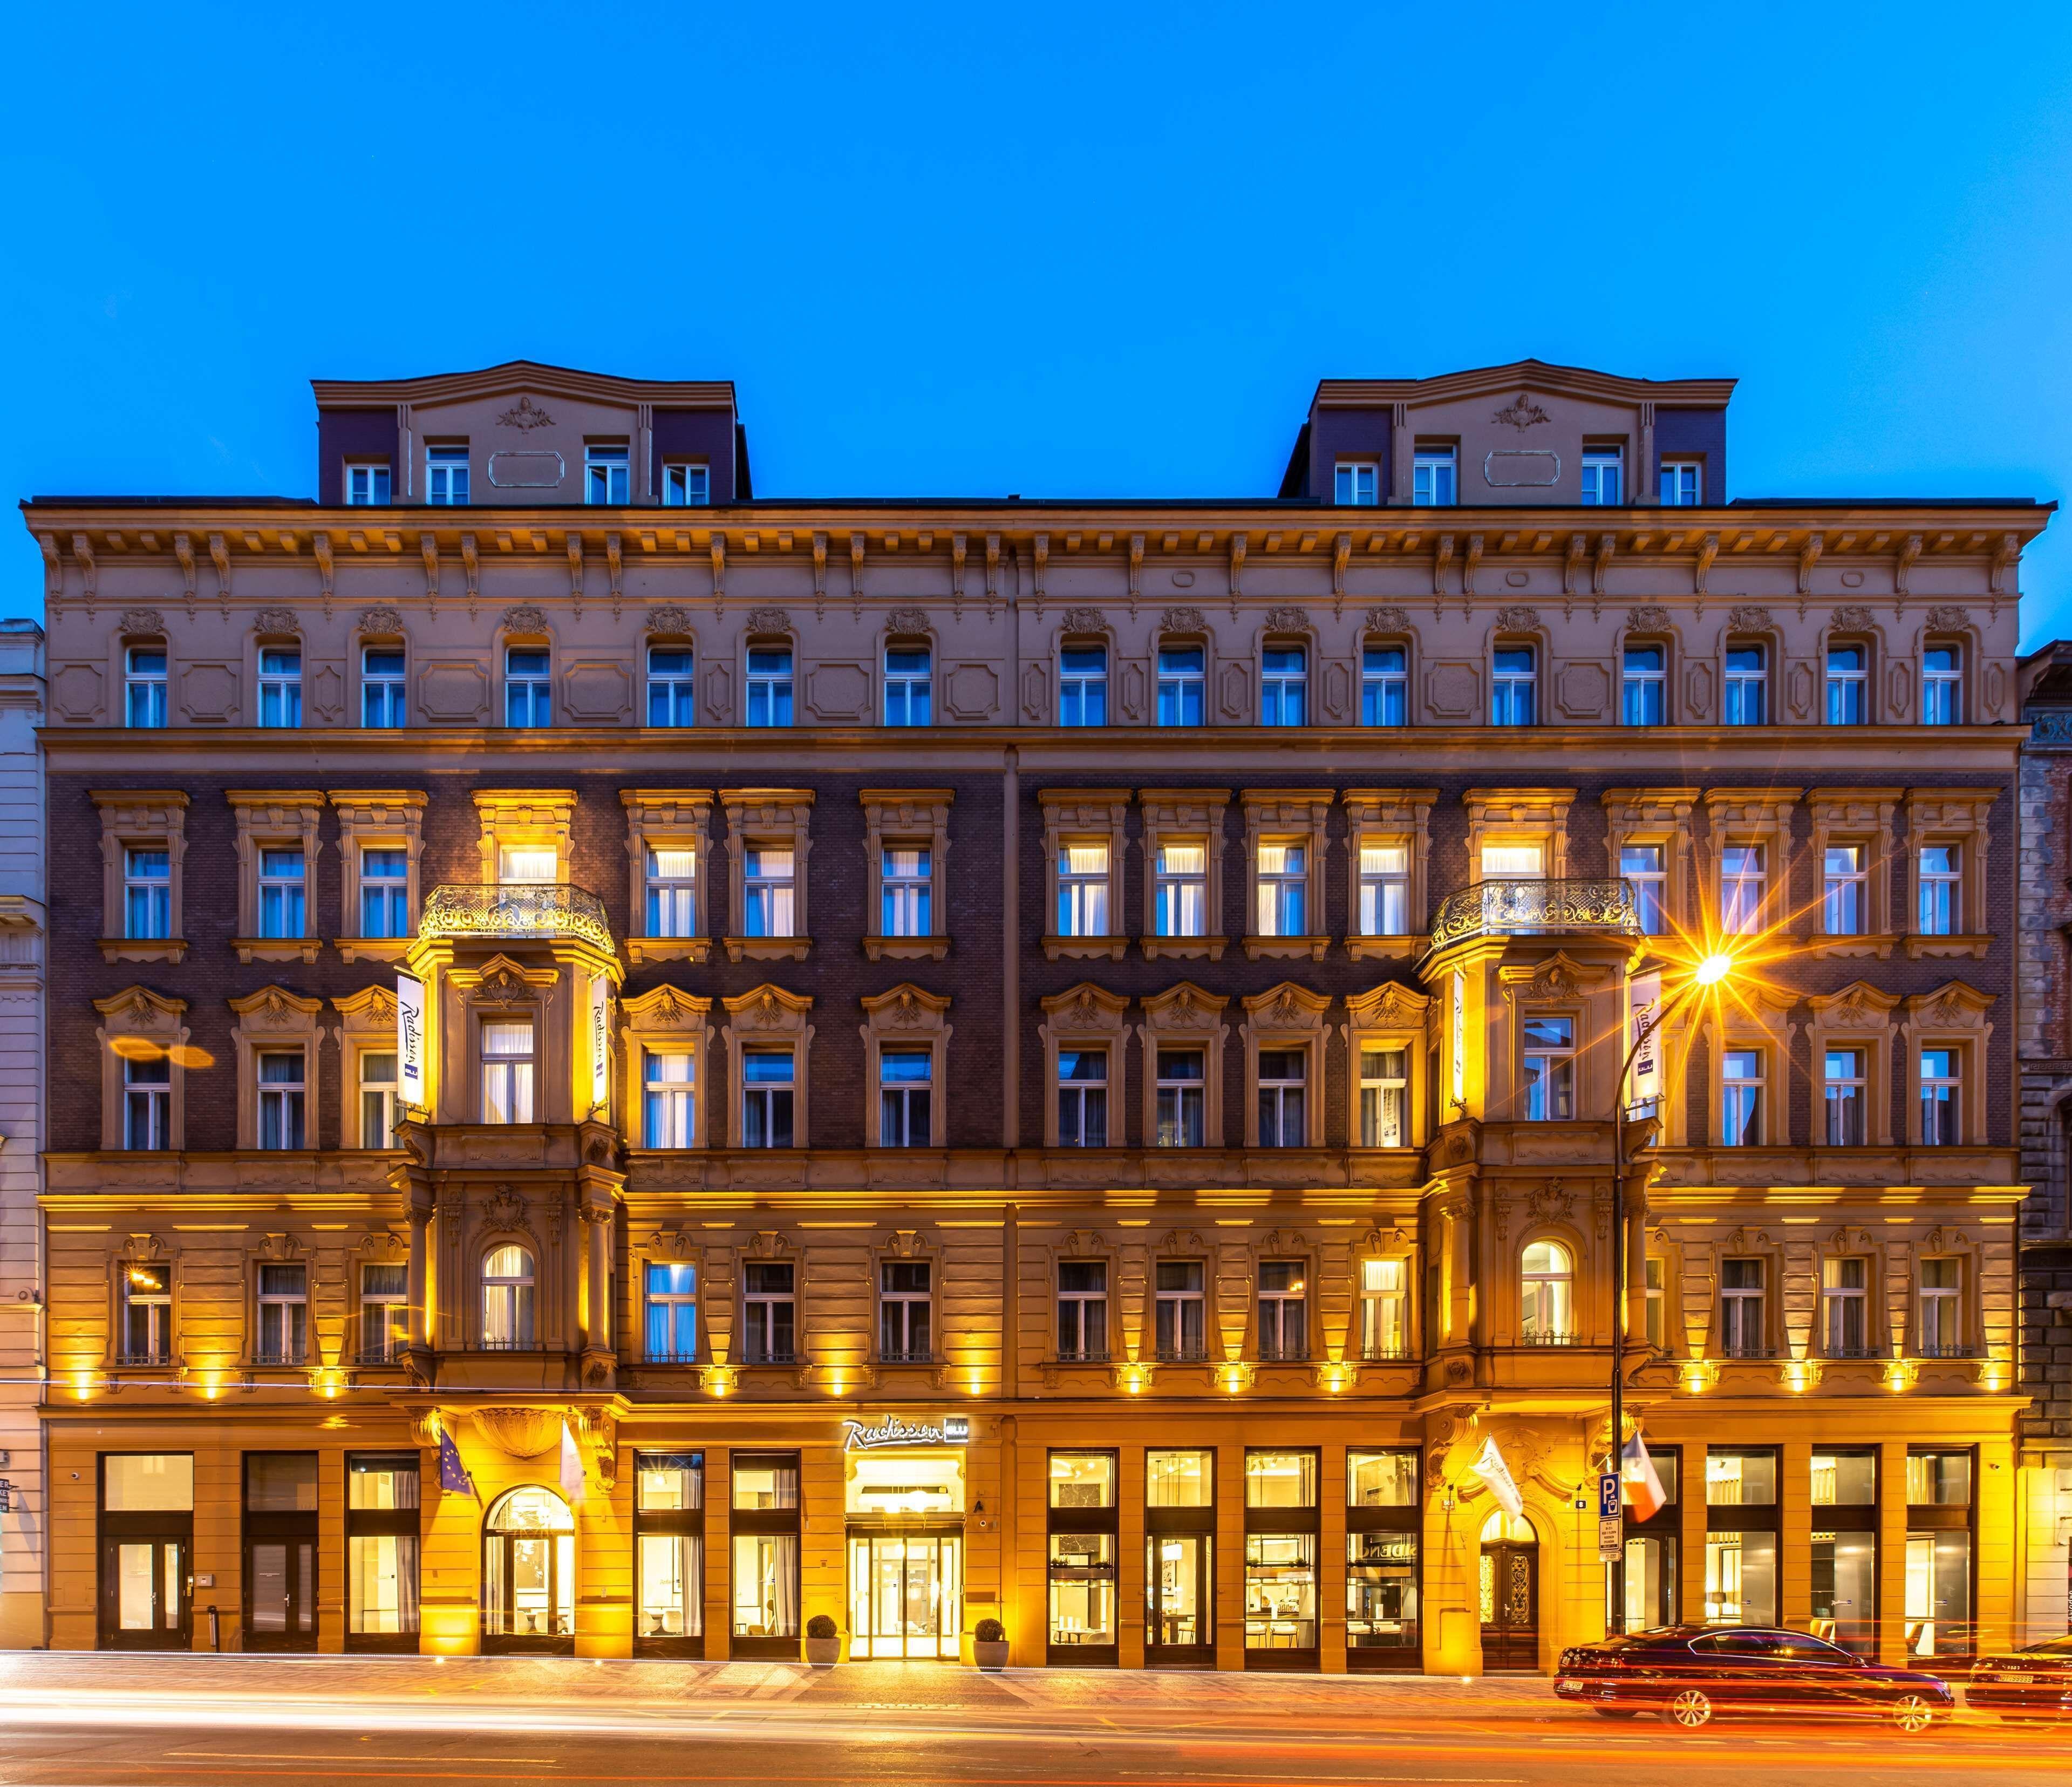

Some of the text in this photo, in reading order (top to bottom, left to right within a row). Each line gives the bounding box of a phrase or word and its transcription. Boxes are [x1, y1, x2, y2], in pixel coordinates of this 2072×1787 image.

[400, 1001, 422, 1063] Radisson
[842, 1414, 943, 1451] Radisson
[1604, 1479, 1616, 1504] P
